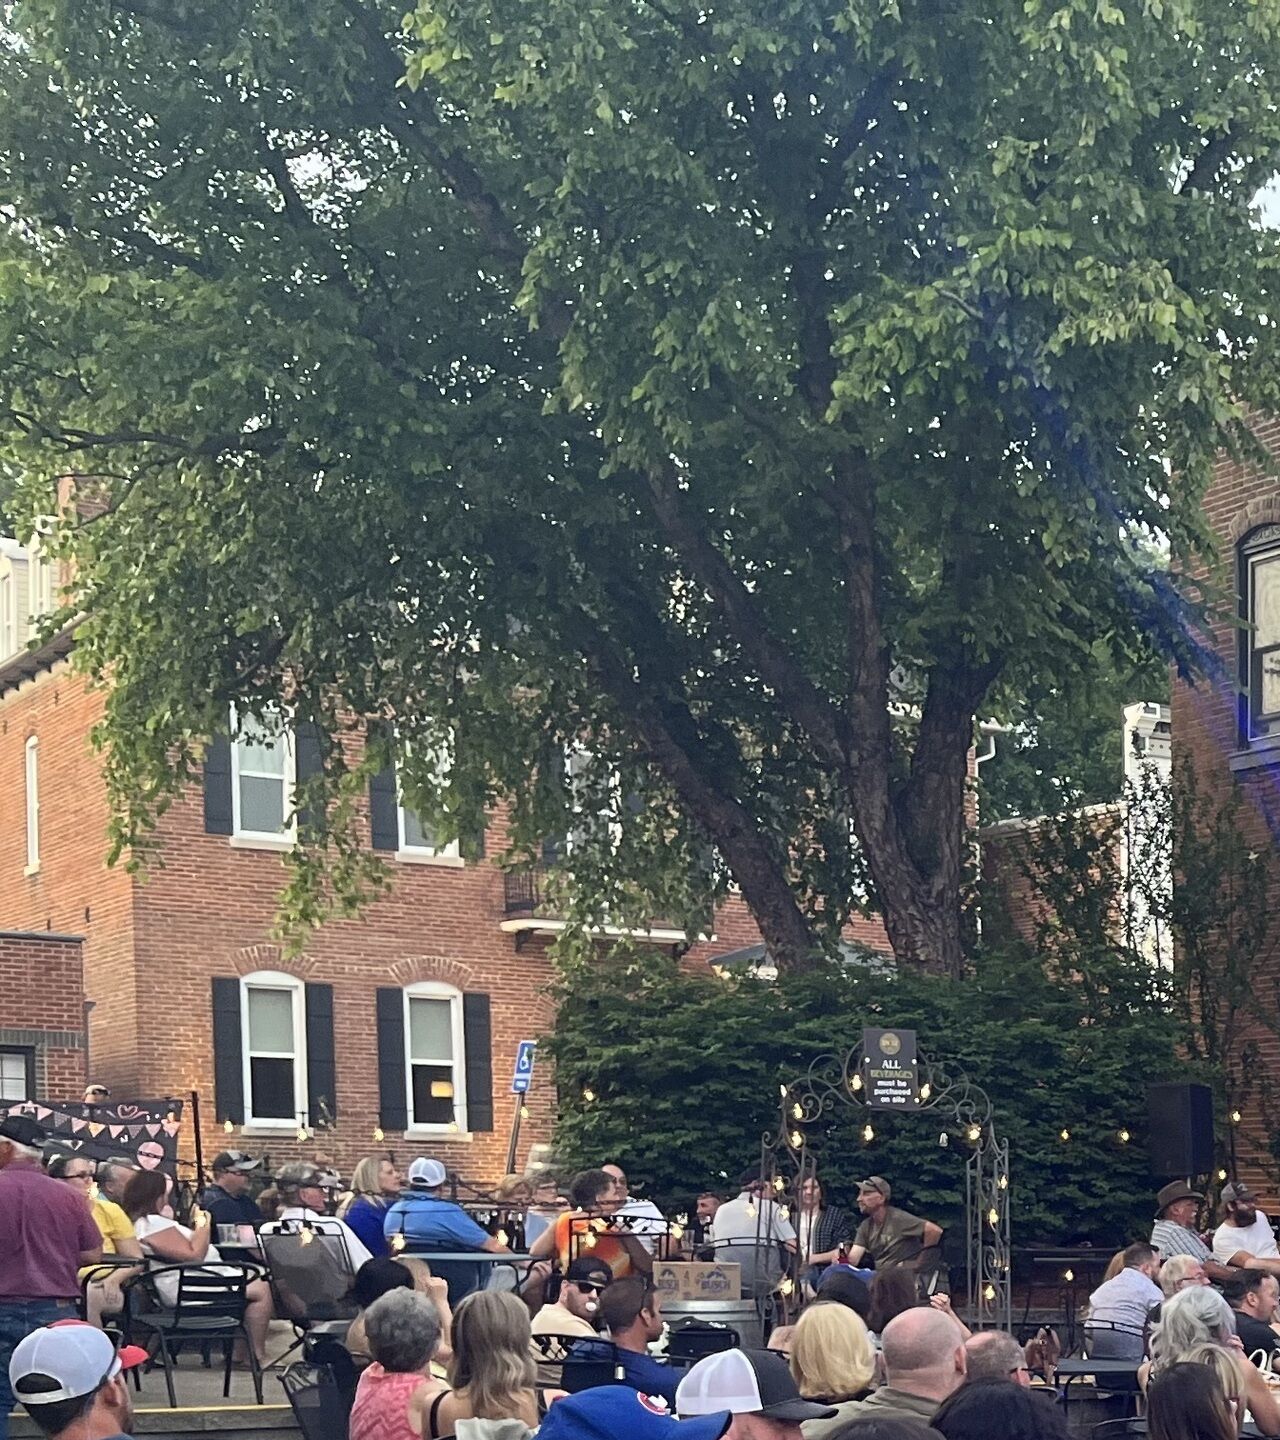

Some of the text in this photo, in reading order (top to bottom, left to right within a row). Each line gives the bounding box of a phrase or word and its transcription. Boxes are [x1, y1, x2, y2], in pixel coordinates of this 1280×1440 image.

[881, 1059, 901, 1069] ALL
[870, 1069, 913, 1078] BEVERAGES
[897, 1079, 908, 1087] be
[873, 1088, 912, 1096] purchased
